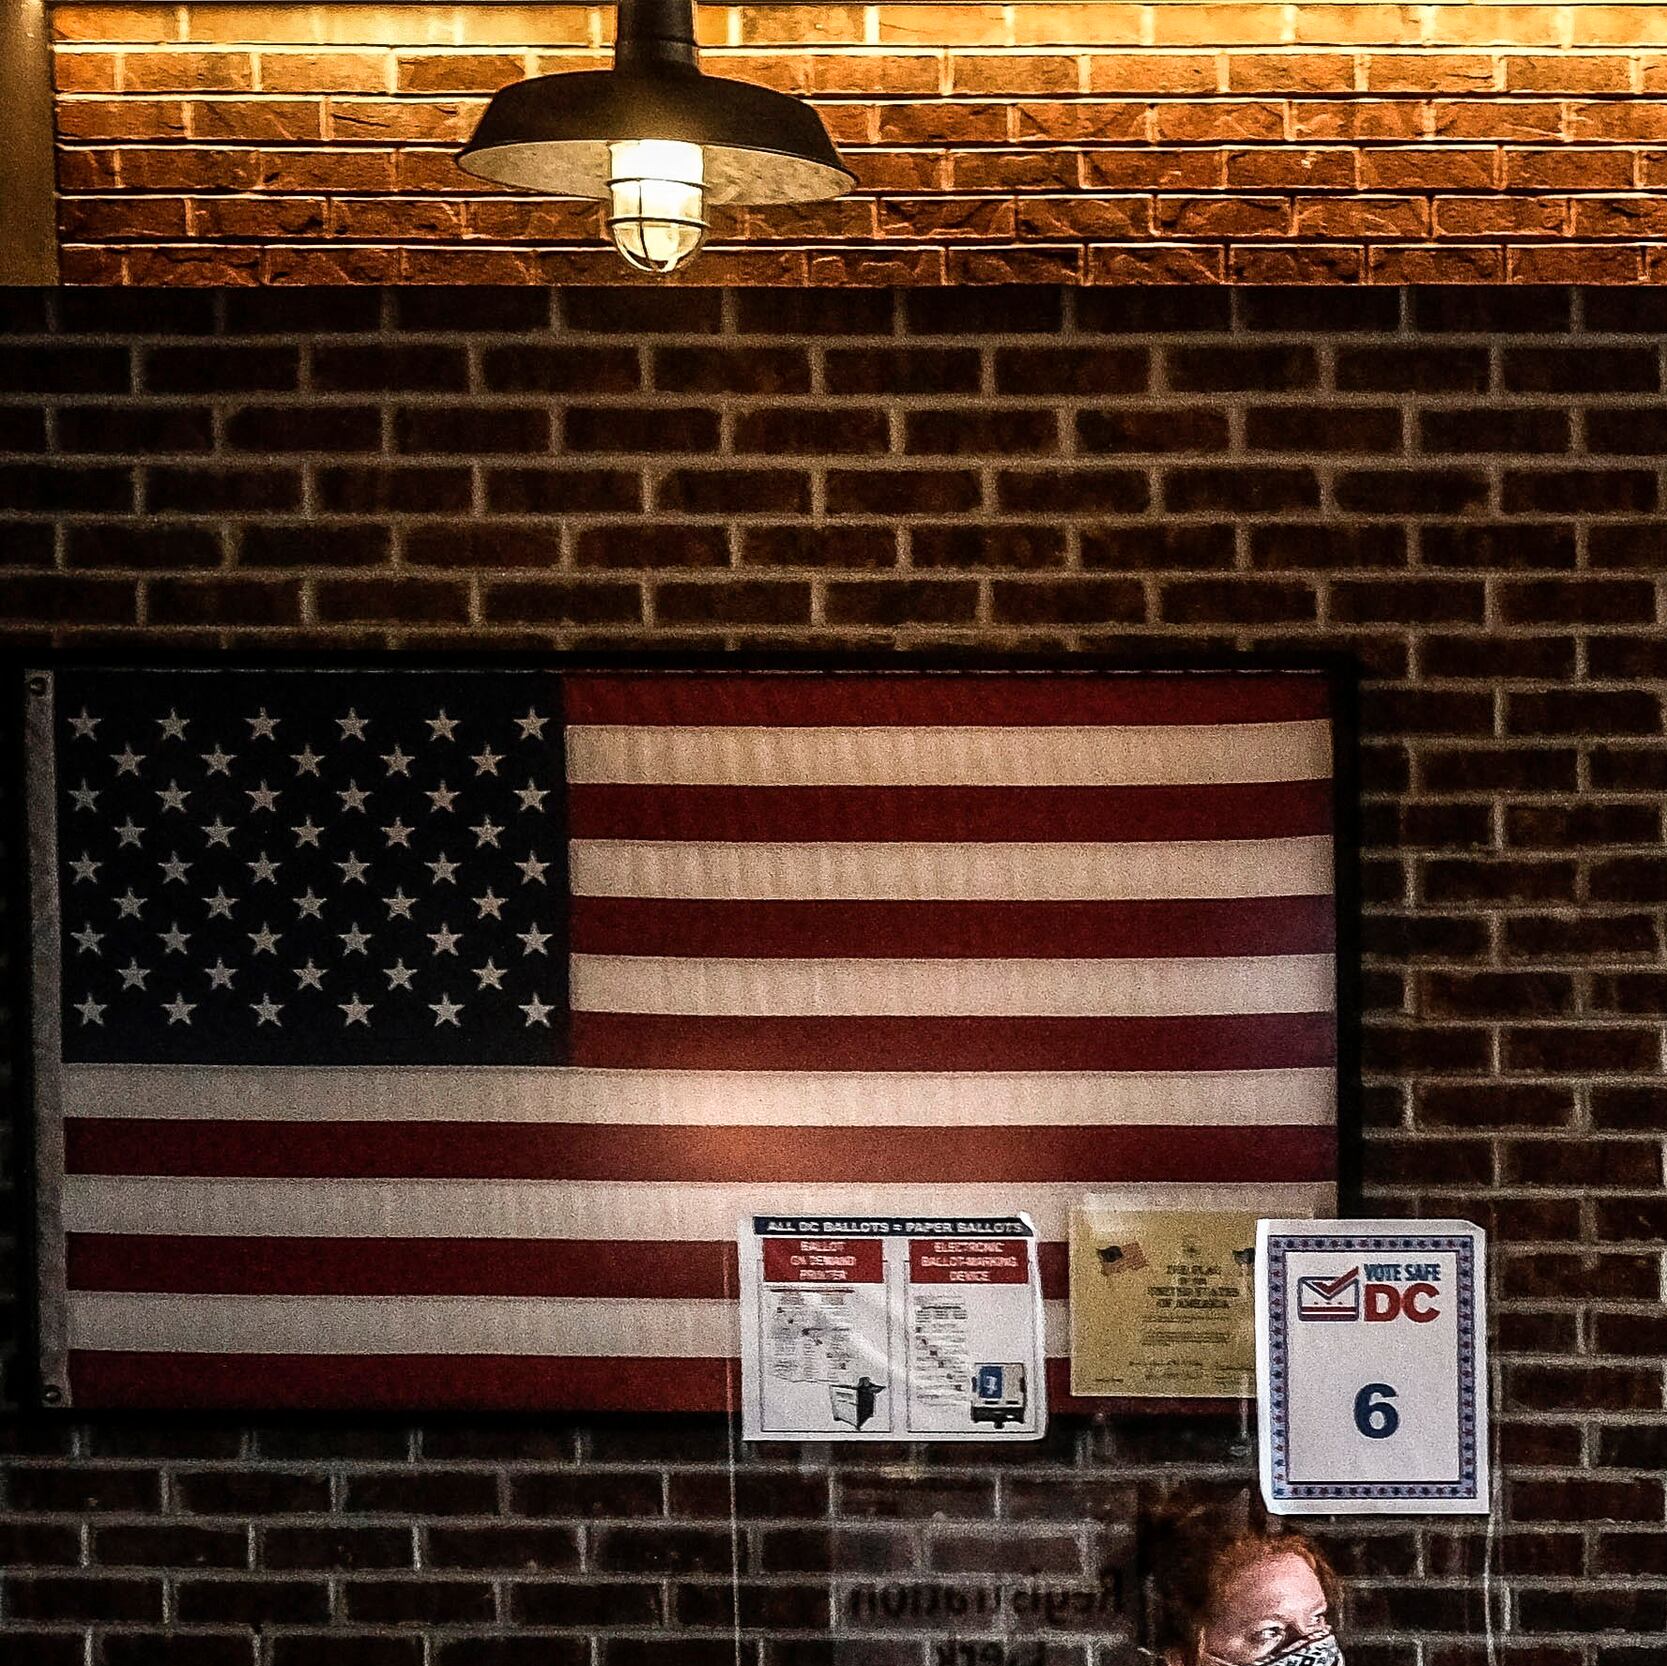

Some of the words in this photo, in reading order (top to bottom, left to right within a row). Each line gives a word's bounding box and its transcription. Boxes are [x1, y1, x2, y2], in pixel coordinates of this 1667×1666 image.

[767, 1221, 796, 1231] ALL
[798, 1221, 819, 1232] DC
[823, 1221, 889, 1232] BALLOTS
[905, 1222, 952, 1233] PAPER
[957, 1222, 1023, 1233] BALLOTS
[800, 1241, 846, 1252] BALLOT
[934, 1241, 1005, 1253] ELECTRONIC
[949, 1271, 991, 1282] DEVICE
[1364, 1263, 1402, 1281] VOTE
[1404, 1263, 1441, 1281] SAFE
[1364, 1283, 1441, 1323] DC
[1354, 1382, 1400, 1439] 6
